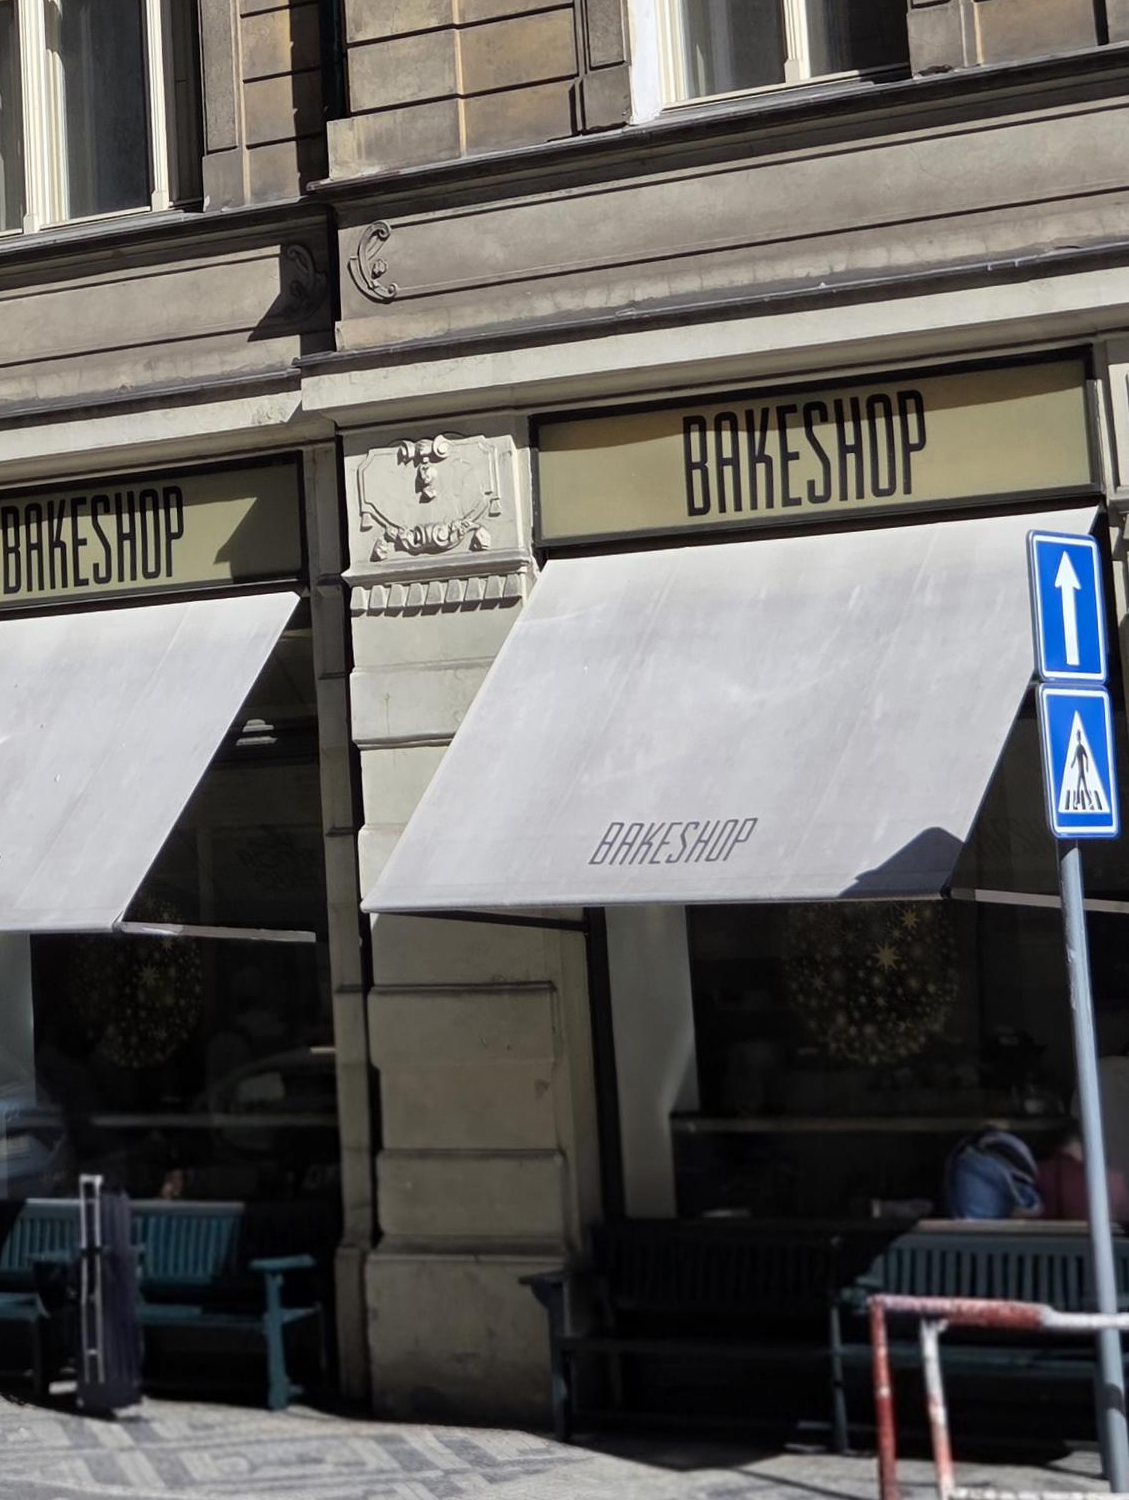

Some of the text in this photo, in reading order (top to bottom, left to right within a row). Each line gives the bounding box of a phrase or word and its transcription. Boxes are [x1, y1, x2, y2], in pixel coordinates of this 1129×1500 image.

[682, 389, 927, 517] BAKESHOP
[1, 485, 185, 595] BAKESHOP
[587, 817, 759, 866] BAKESHOP
